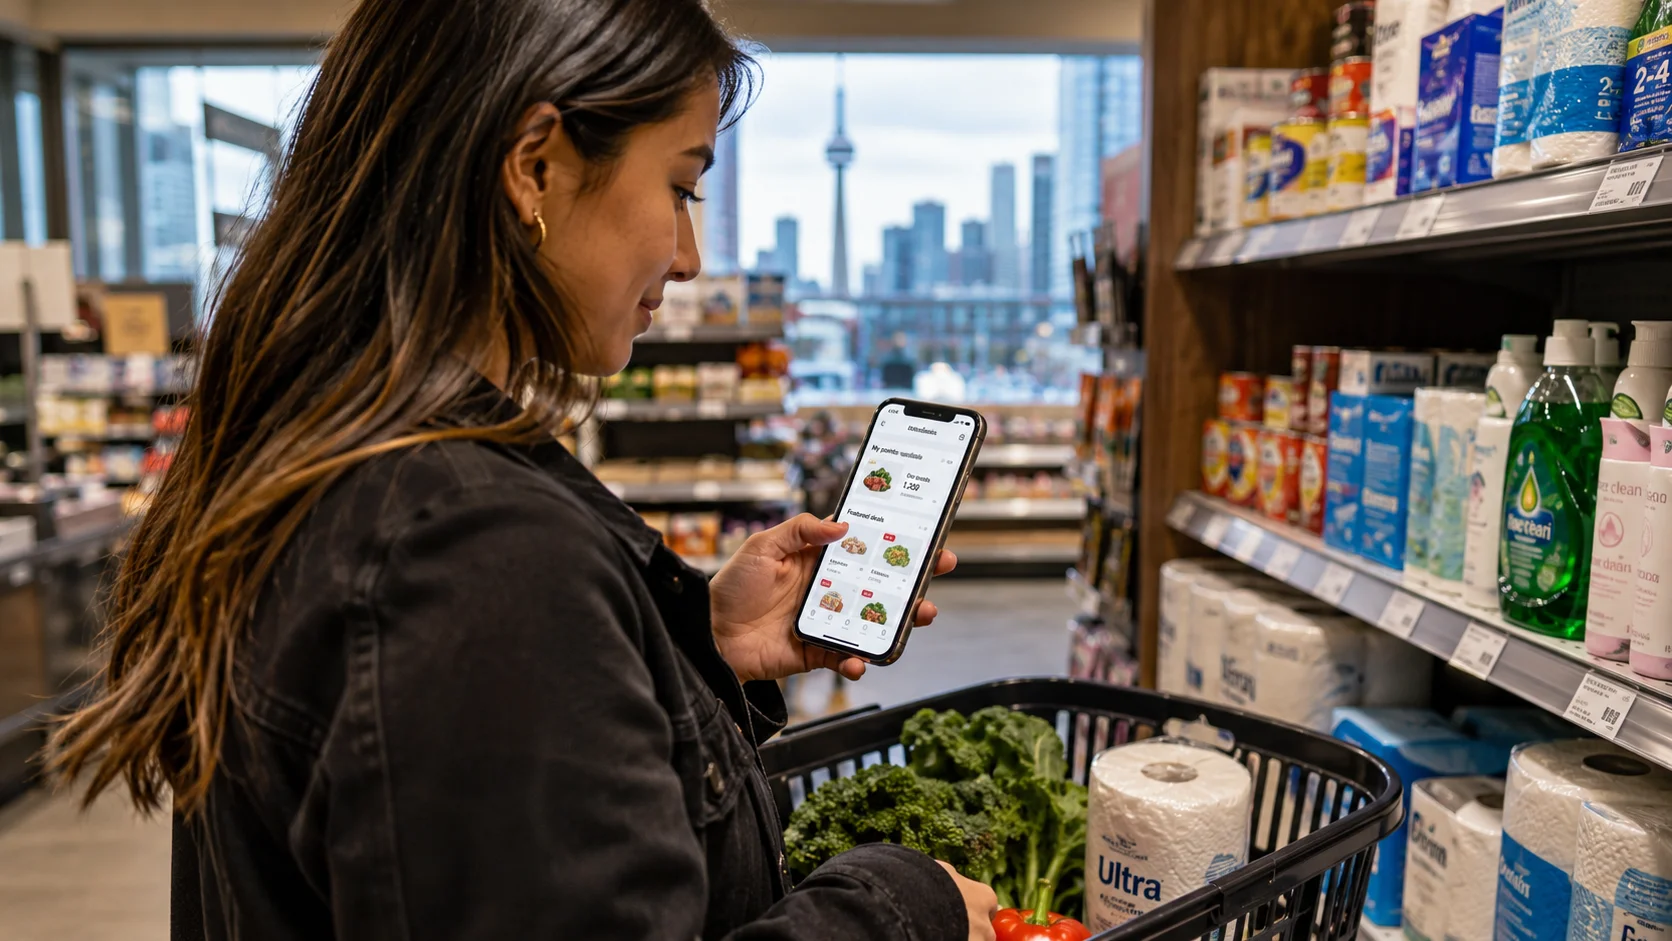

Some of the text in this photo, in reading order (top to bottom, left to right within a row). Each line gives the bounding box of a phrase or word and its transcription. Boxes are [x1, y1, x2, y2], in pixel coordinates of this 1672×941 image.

[1633, 59, 1670, 95] 2-4
[1610, 481, 1642, 497] clean
[1098, 854, 1161, 902] Ultra
